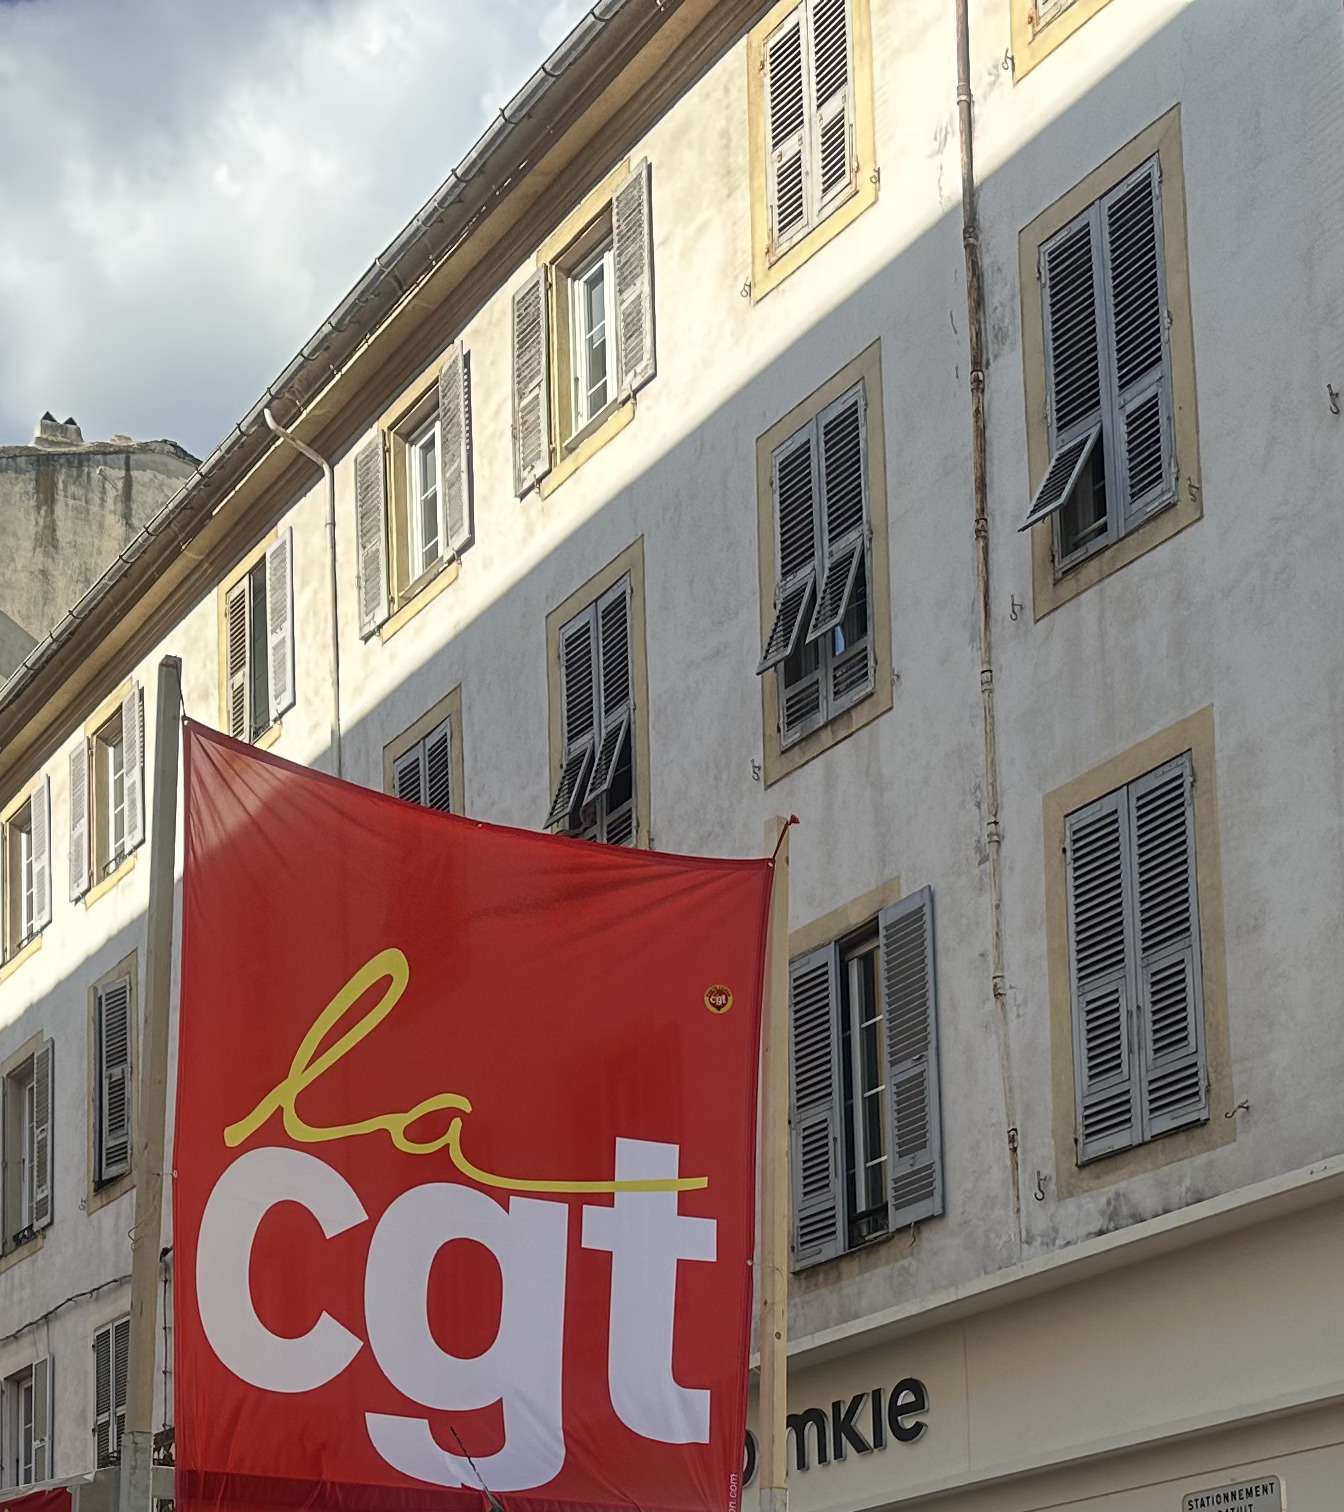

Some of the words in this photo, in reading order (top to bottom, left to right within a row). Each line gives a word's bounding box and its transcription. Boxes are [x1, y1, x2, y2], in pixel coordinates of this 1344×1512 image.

[224, 947, 708, 1192] la
[196, 1137, 718, 1492] cgt
[743, 1377, 930, 1487] mkie
[1188, 1482, 1275, 1511] STATIONNEMENT
